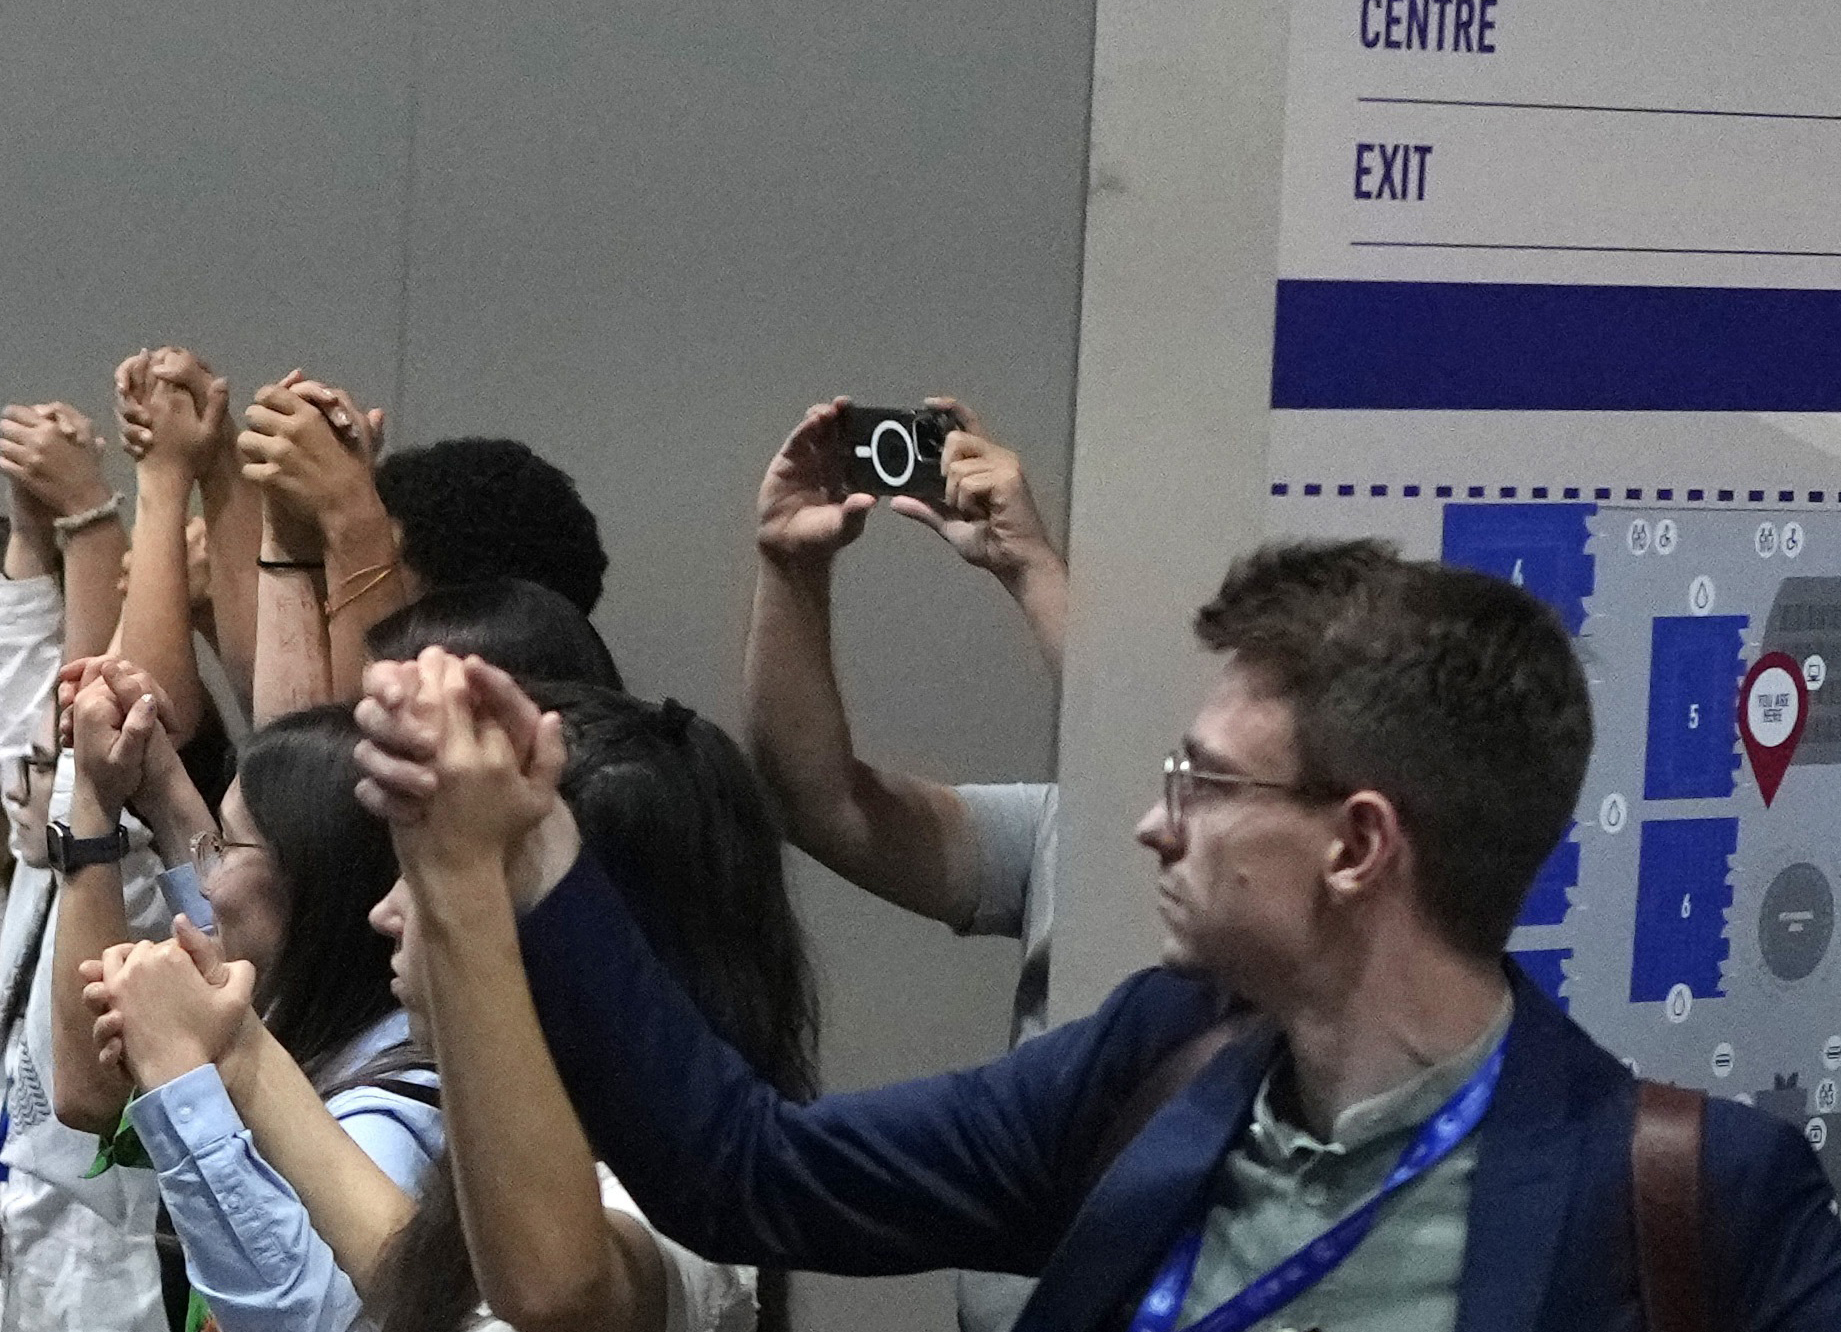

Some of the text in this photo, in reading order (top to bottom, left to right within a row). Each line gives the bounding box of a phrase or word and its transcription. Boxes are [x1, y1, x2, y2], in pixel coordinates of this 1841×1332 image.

[1360, 0, 1498, 53] CENTRE
[1354, 143, 1434, 201] EXIT
[1688, 703, 1700, 729] 5
[1680, 893, 1691, 919] 6
